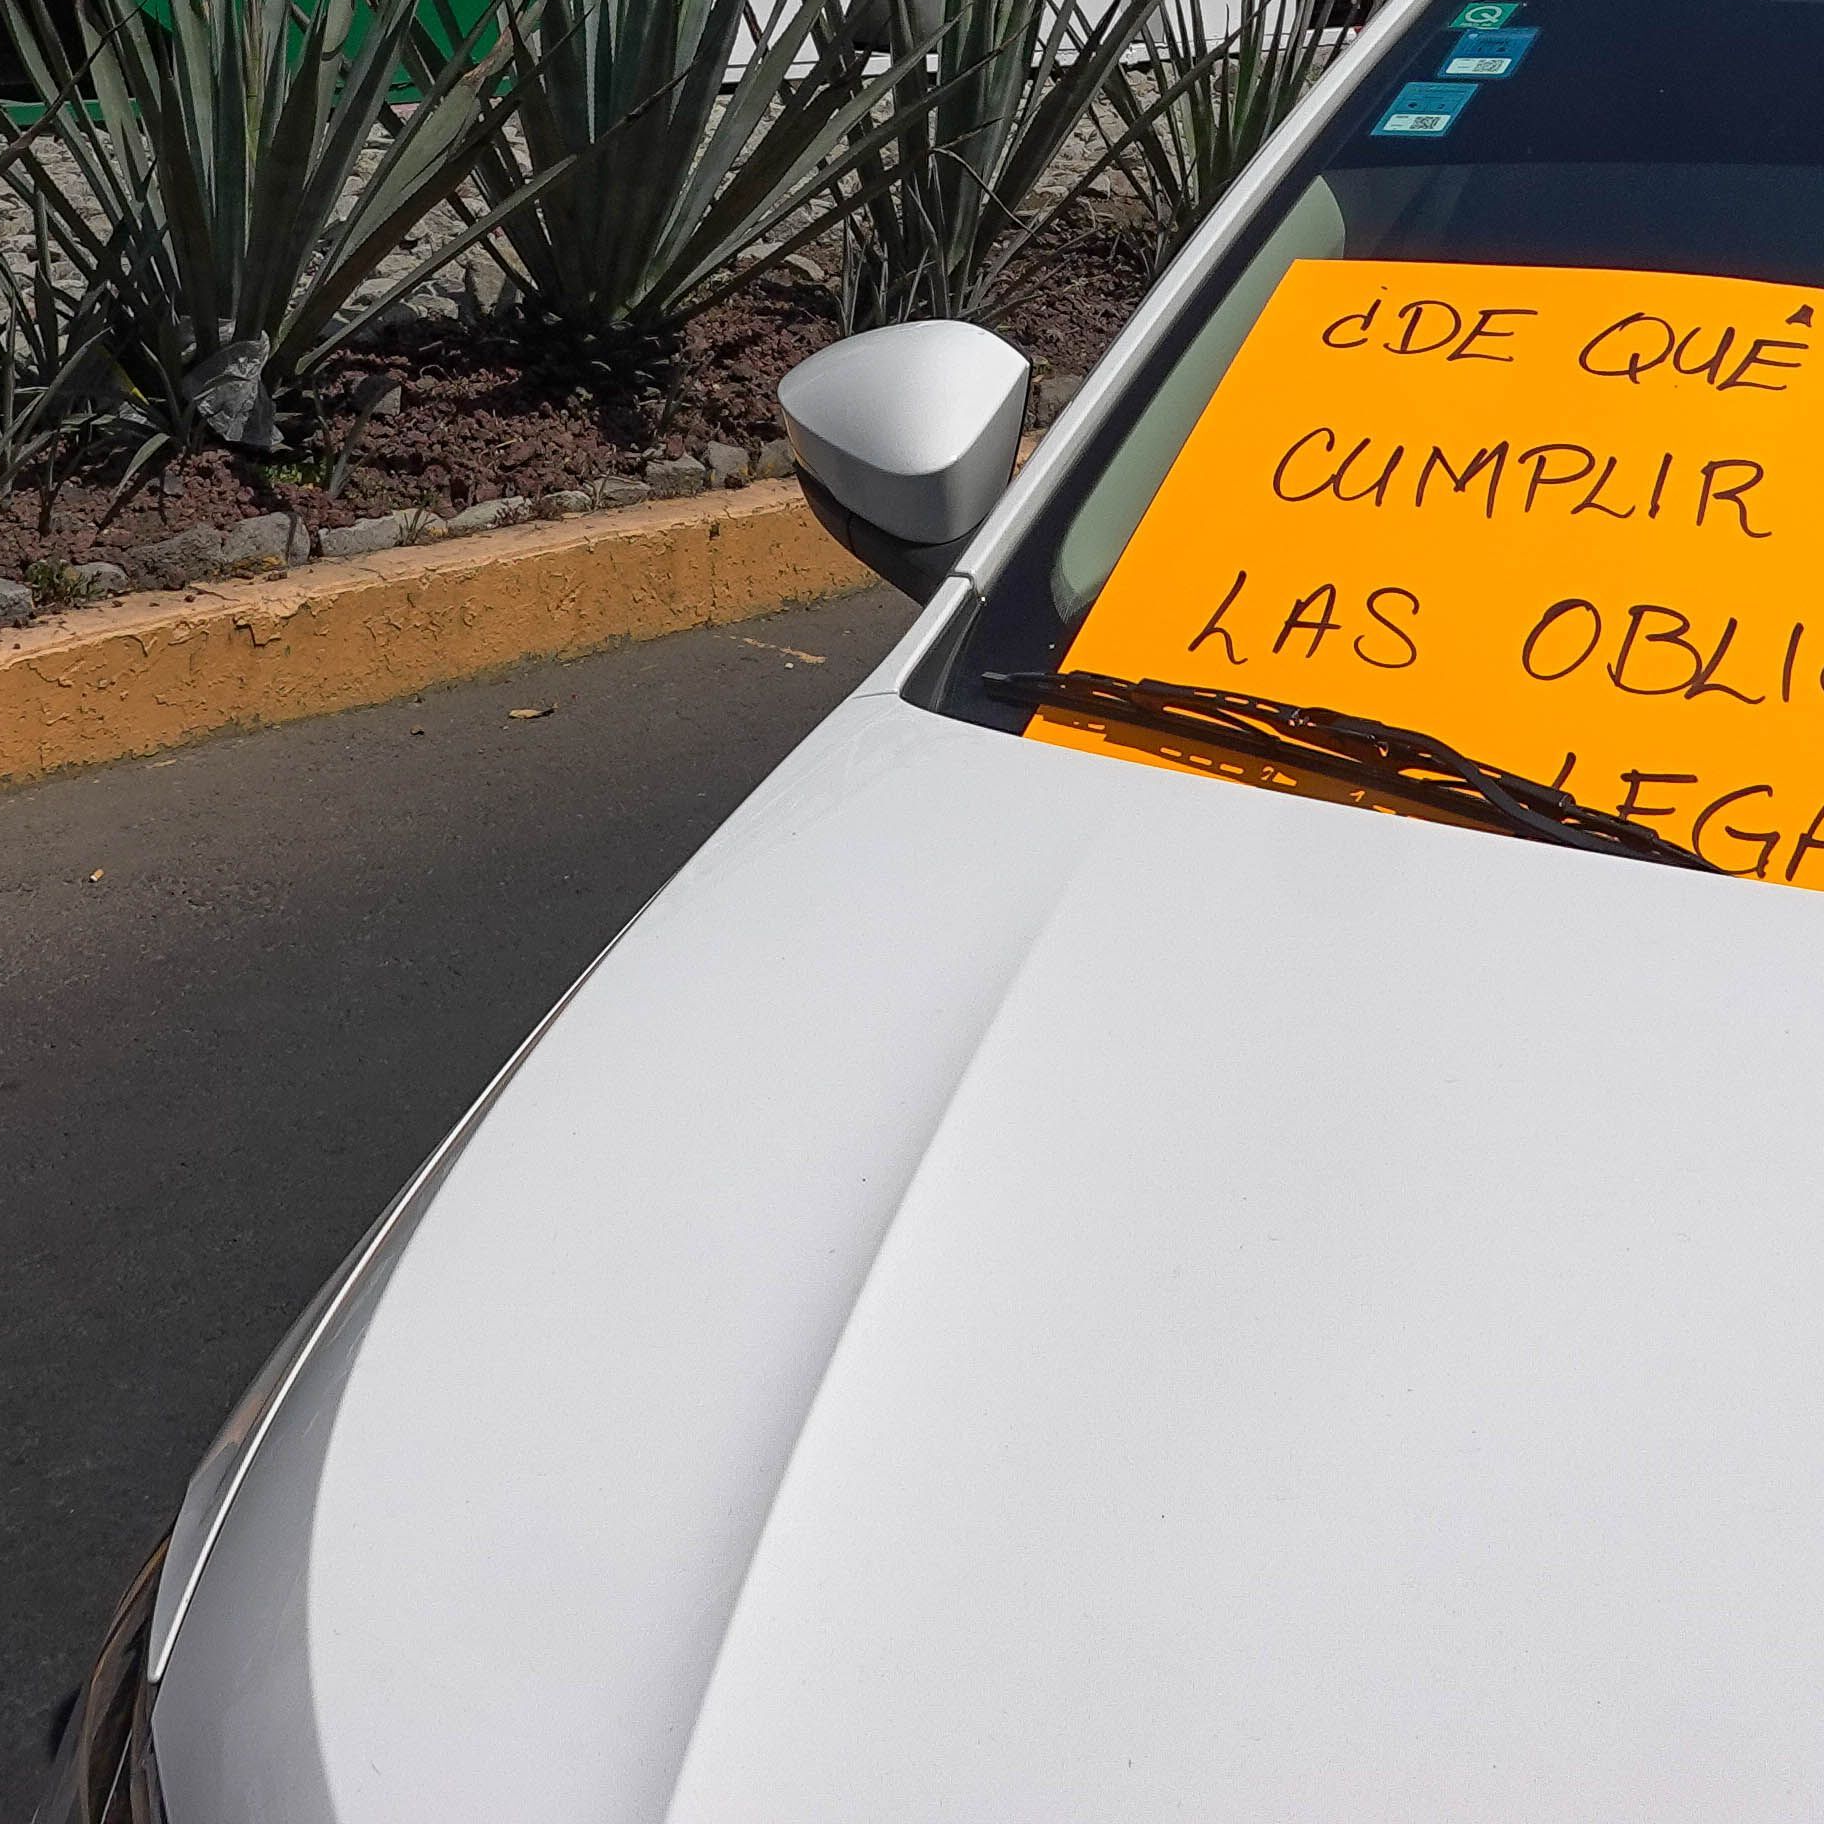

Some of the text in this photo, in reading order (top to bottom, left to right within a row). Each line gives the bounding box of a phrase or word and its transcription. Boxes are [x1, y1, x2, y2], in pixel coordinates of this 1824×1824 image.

[1321, 285, 1538, 363] ¿DE
[1272, 427, 1773, 539] CUMPLIR
[1187, 569, 1420, 668] LAS
